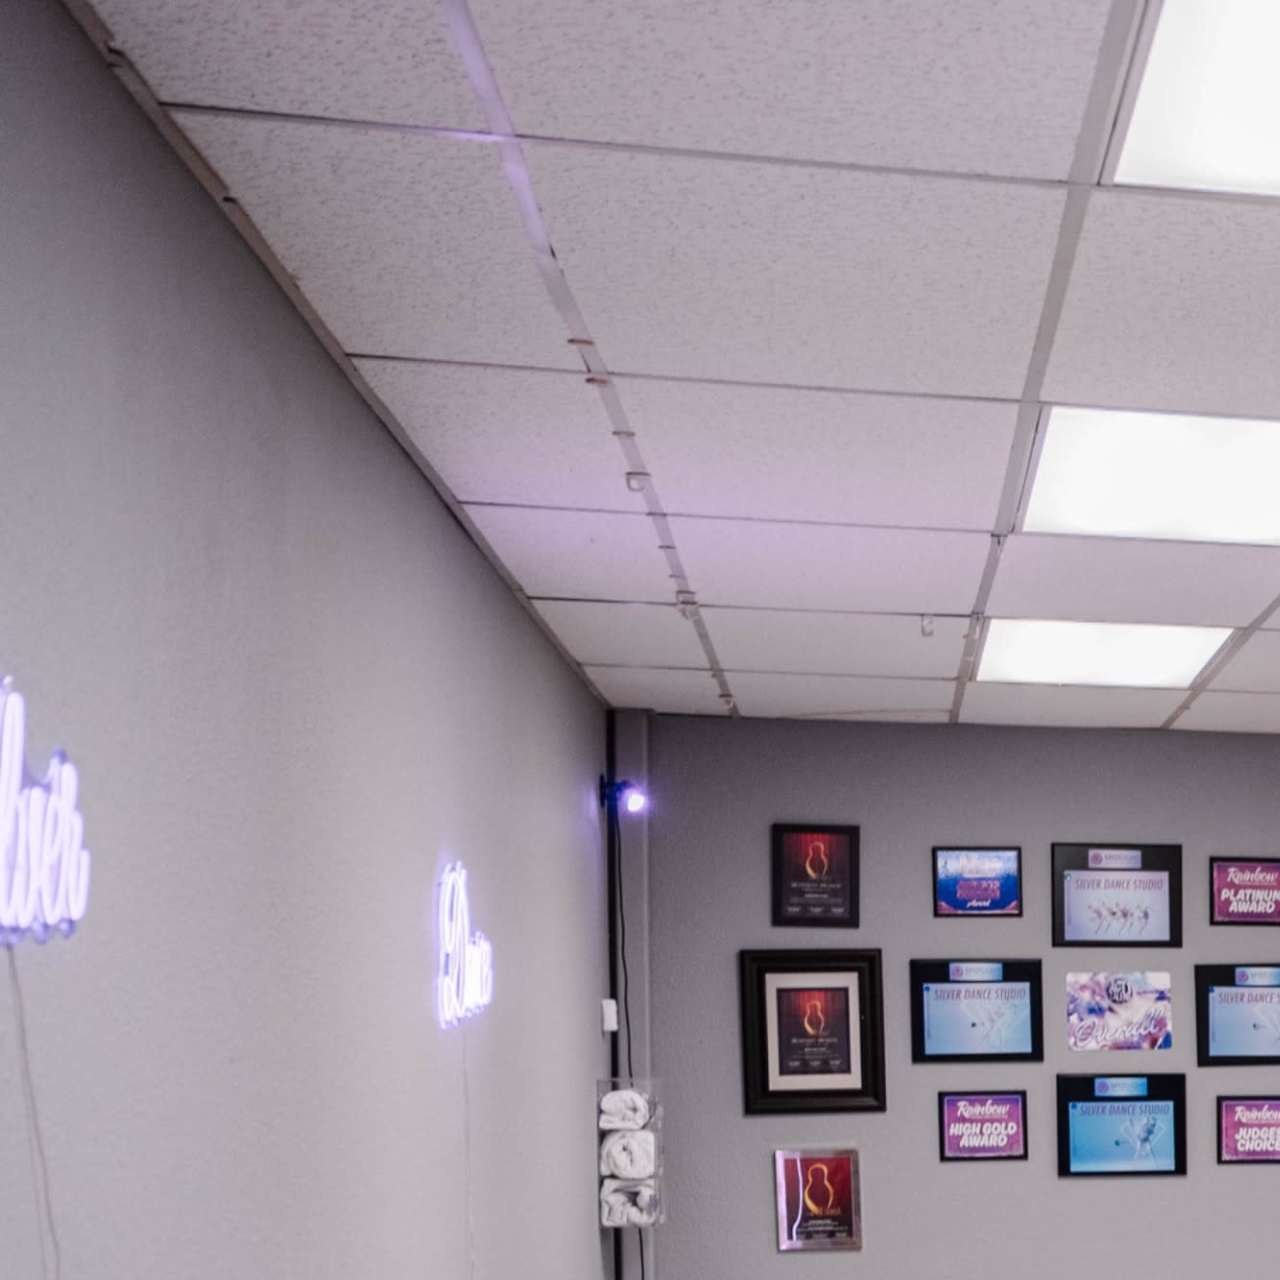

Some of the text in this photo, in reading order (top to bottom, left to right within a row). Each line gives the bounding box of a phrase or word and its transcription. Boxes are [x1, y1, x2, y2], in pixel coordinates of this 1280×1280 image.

[1227, 866, 1280, 885] Rainbow
[1075, 879, 1164, 891] SILVER DANCE STUDIO
[1228, 901, 1276, 914] AWARD
[934, 987, 1026, 1000] SILVER DANCE STUDIO
[1218, 991, 1246, 1003] SILVER
[956, 1099, 1010, 1119] Rainbow
[1079, 1103, 1170, 1116] SILVER DANCE STUDIO
[949, 1122, 1017, 1136] HIGH GOLD
[959, 1135, 1008, 1147] AWARD
